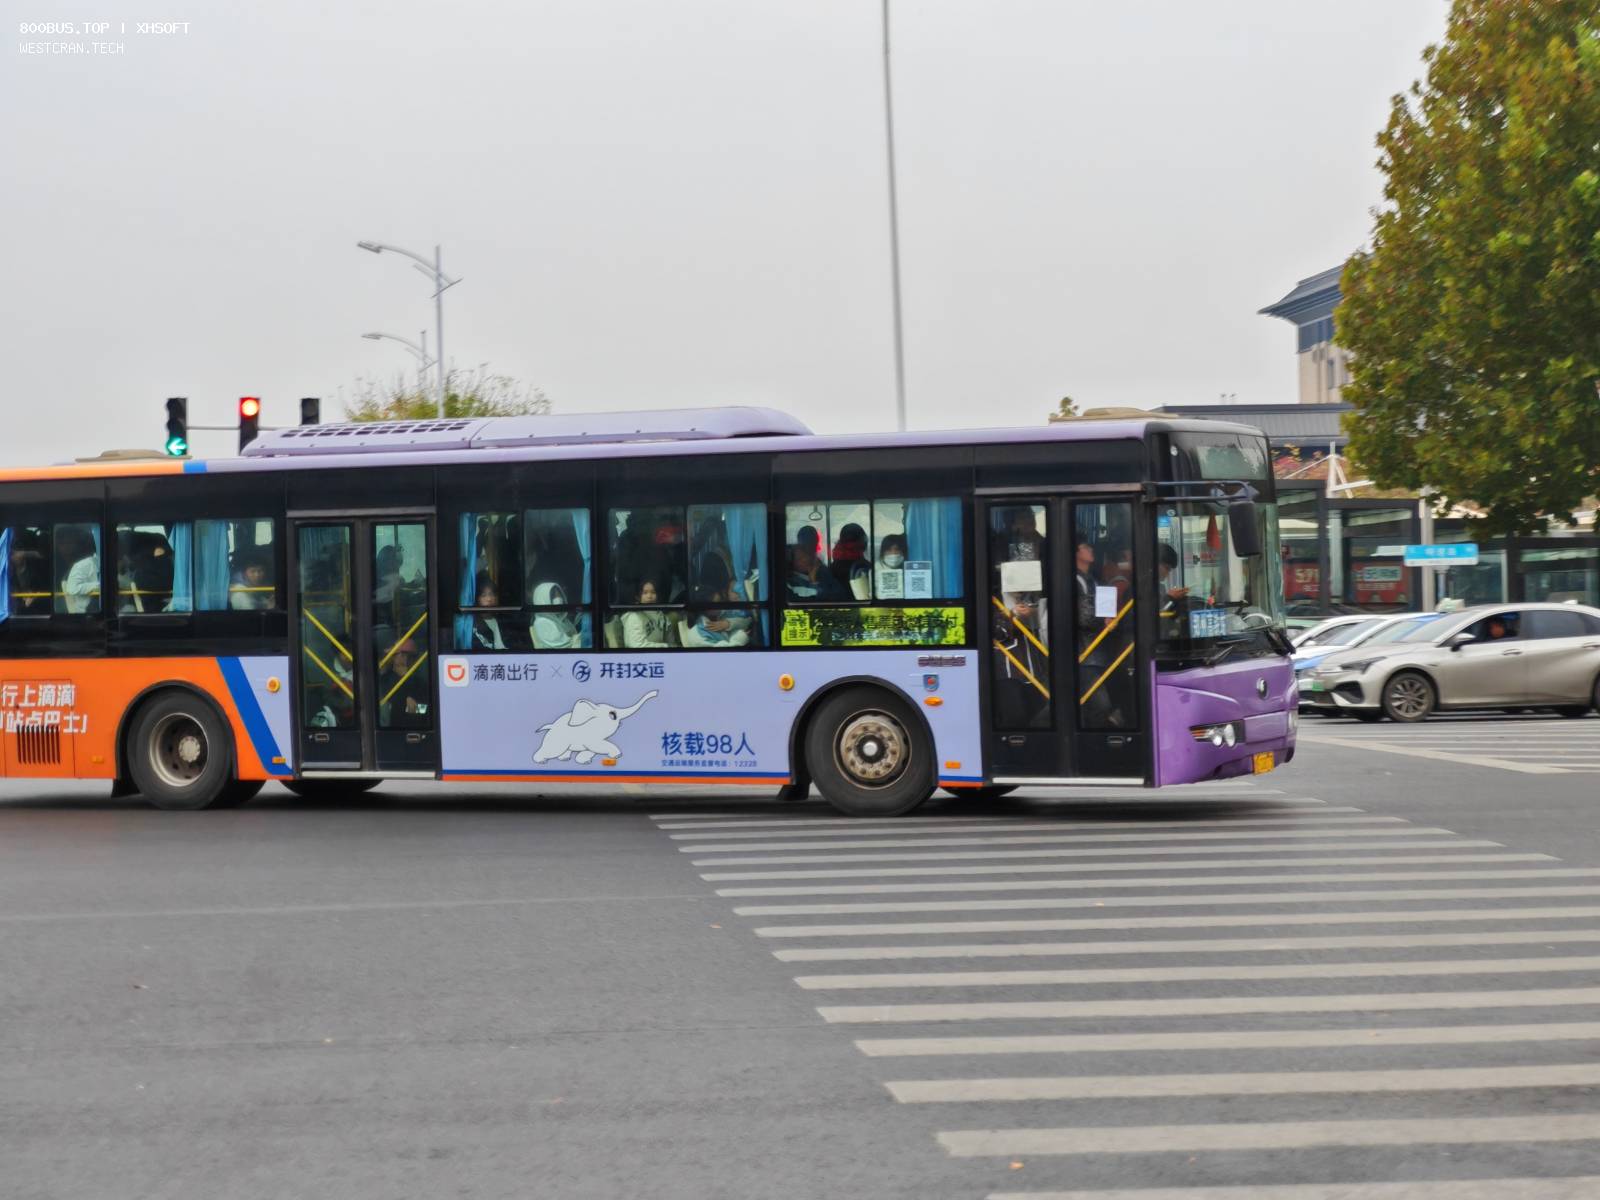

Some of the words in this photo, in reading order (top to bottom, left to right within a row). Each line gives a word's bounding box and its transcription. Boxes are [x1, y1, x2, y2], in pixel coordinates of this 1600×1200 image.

[473, 663, 539, 681] 滴滴出行
[600, 662, 665, 679] 开封交运
[2, 684, 75, 707] 行上滴滴
[661, 731, 755, 756] 核载98人
